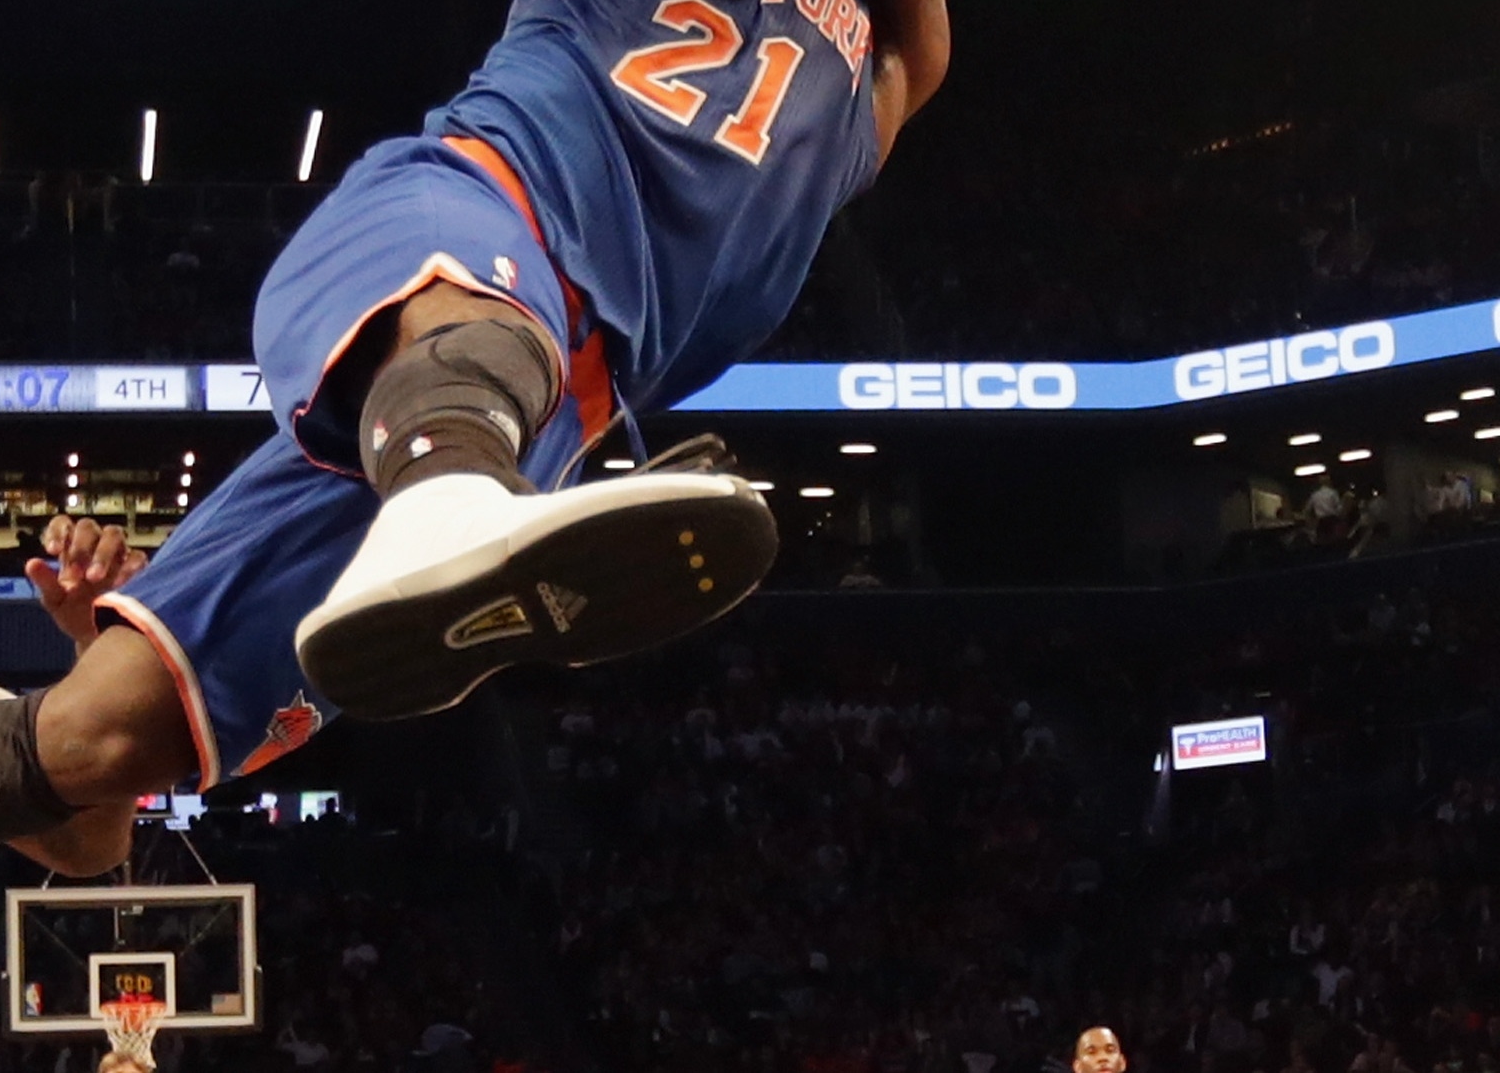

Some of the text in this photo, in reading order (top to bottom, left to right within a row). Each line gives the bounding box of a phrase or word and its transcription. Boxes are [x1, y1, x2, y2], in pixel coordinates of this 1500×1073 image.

[1174, 321, 1396, 402] GEICO
[113, 378, 168, 400] 4TH
[241, 371, 263, 406] 7
[837, 362, 1077, 410] GEICO
